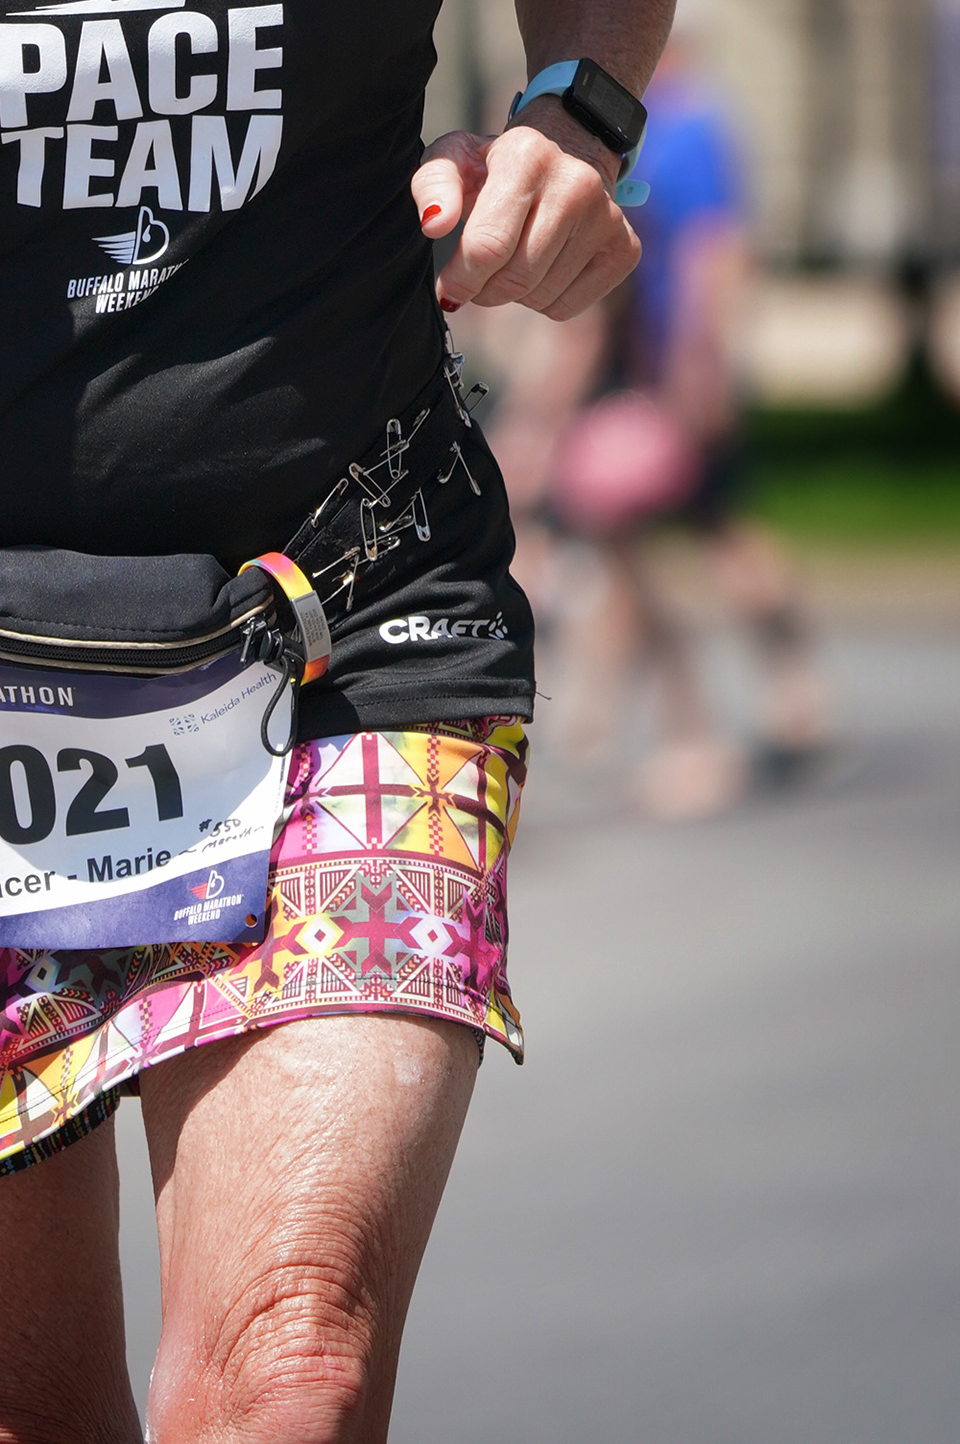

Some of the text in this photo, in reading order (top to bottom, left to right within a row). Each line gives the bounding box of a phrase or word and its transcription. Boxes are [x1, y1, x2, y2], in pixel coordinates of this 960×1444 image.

[0, 115, 284, 212] TEAM
[67, 258, 190, 298] BUFFALO MARAT
[95, 285, 159, 314] WEEKEN
[379, 615, 490, 644] CRAFT
[200, 672, 277, 724] Kaleida Health
[87, 847, 172, 883] Marie
[173, 894, 242, 921] BUFFALO MARATHON
[187, 908, 221, 926] WEEKEND
